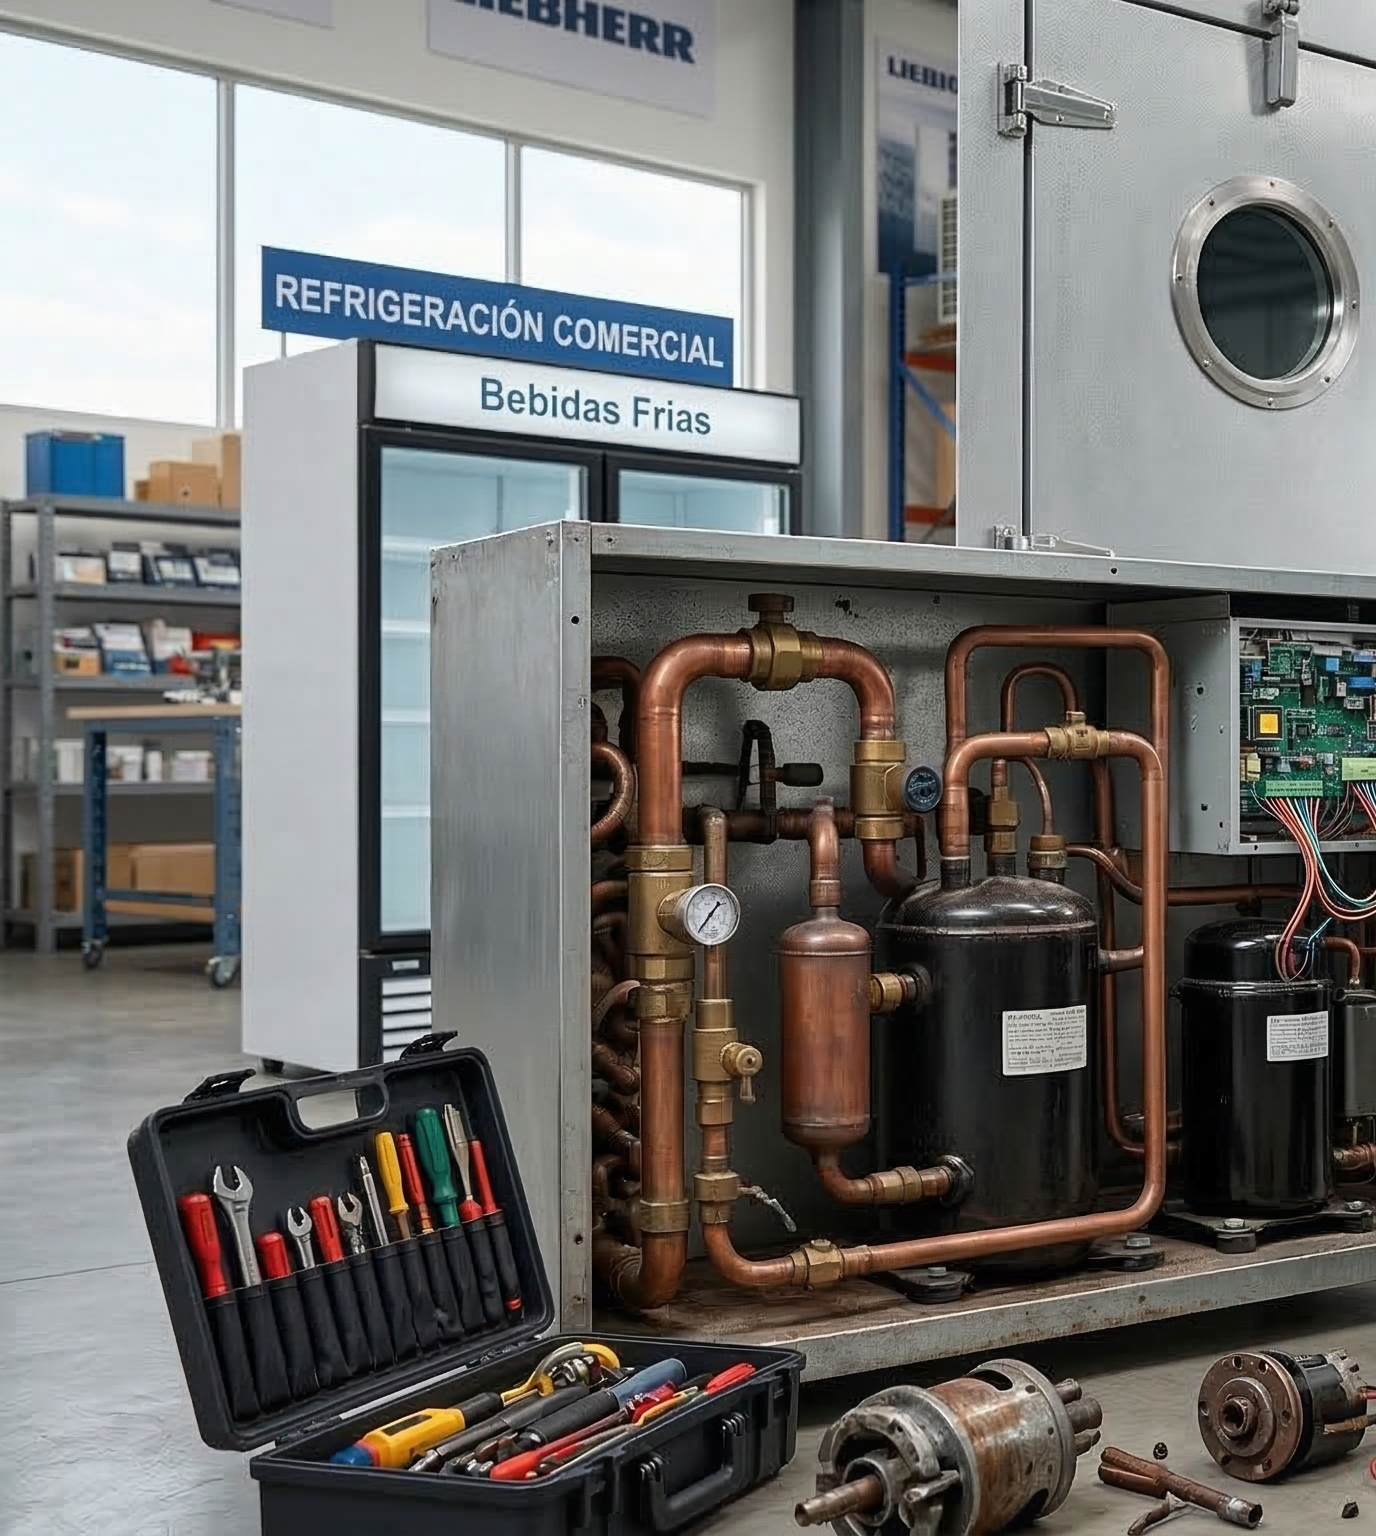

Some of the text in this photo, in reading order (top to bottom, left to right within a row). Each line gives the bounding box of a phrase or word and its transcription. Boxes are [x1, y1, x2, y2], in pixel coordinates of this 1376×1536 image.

[453, 0, 694, 63] BHERR
[276, 273, 724, 368] REFRIGERACIÓN COMERCIAL
[480, 377, 712, 436] Bebidas Frias
